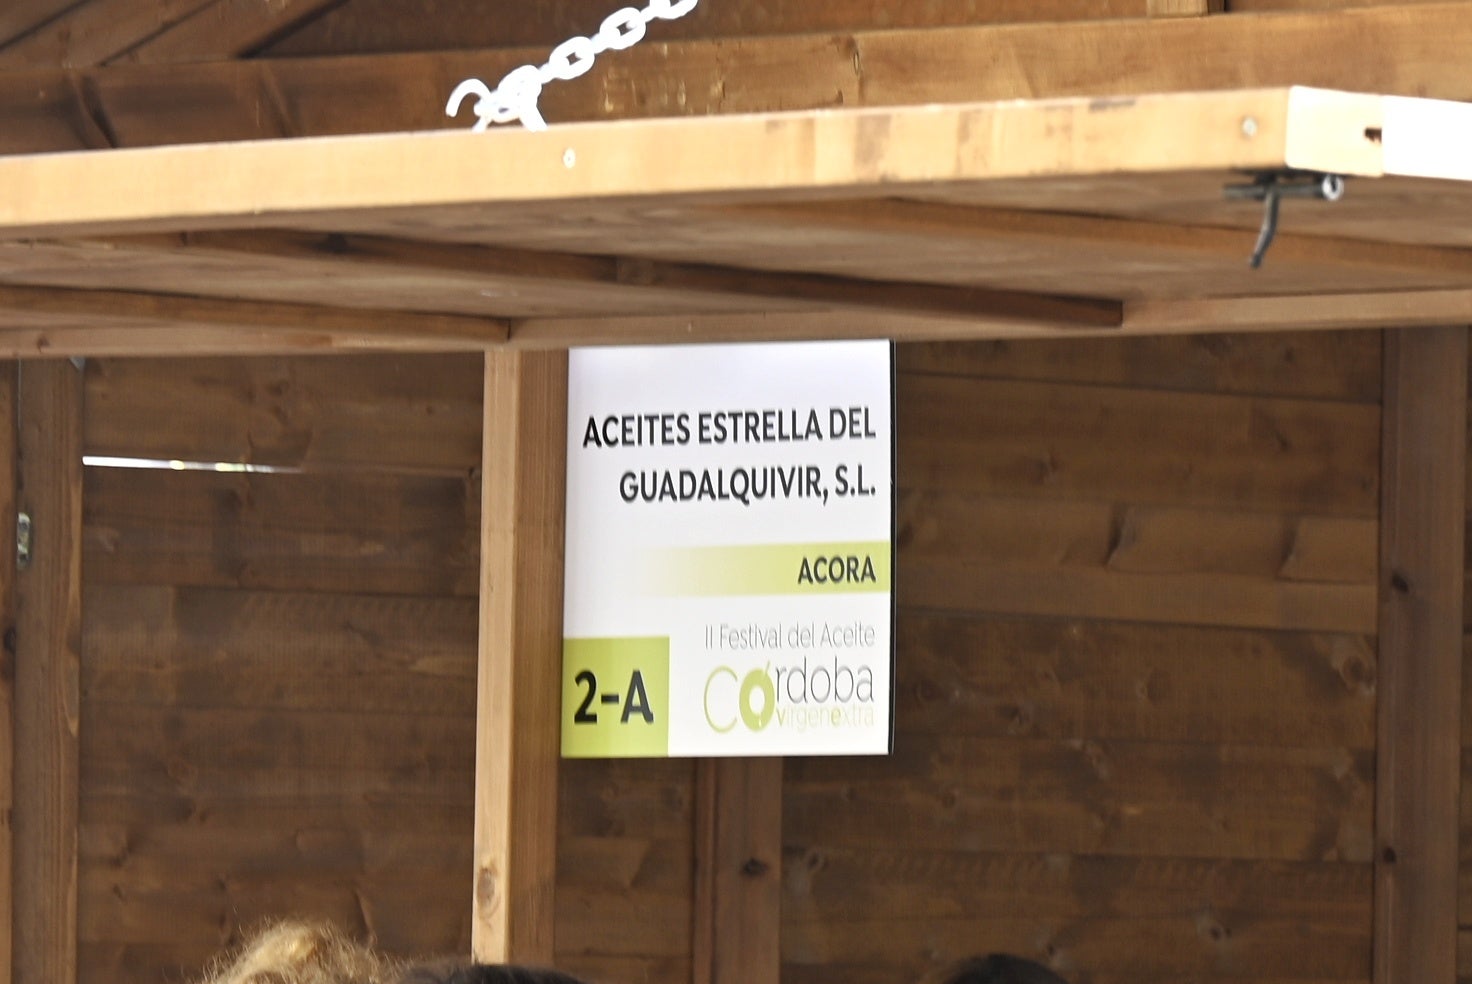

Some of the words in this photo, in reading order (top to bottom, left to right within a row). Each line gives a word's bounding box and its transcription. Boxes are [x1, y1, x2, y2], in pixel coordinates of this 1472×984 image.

[583, 413, 691, 448] ACEITES
[698, 408, 823, 444] ESTRELLA
[829, 406, 876, 439] DEL
[619, 465, 829, 507] GUADALQUIVIR,
[834, 463, 876, 497] S.L.
[797, 555, 876, 585] ACORA
[704, 624, 713, 650] II
[719, 621, 782, 650] Festival
[787, 620, 815, 649] del
[820, 620, 875, 649] Aceite
[573, 669, 655, 725] 2-A
